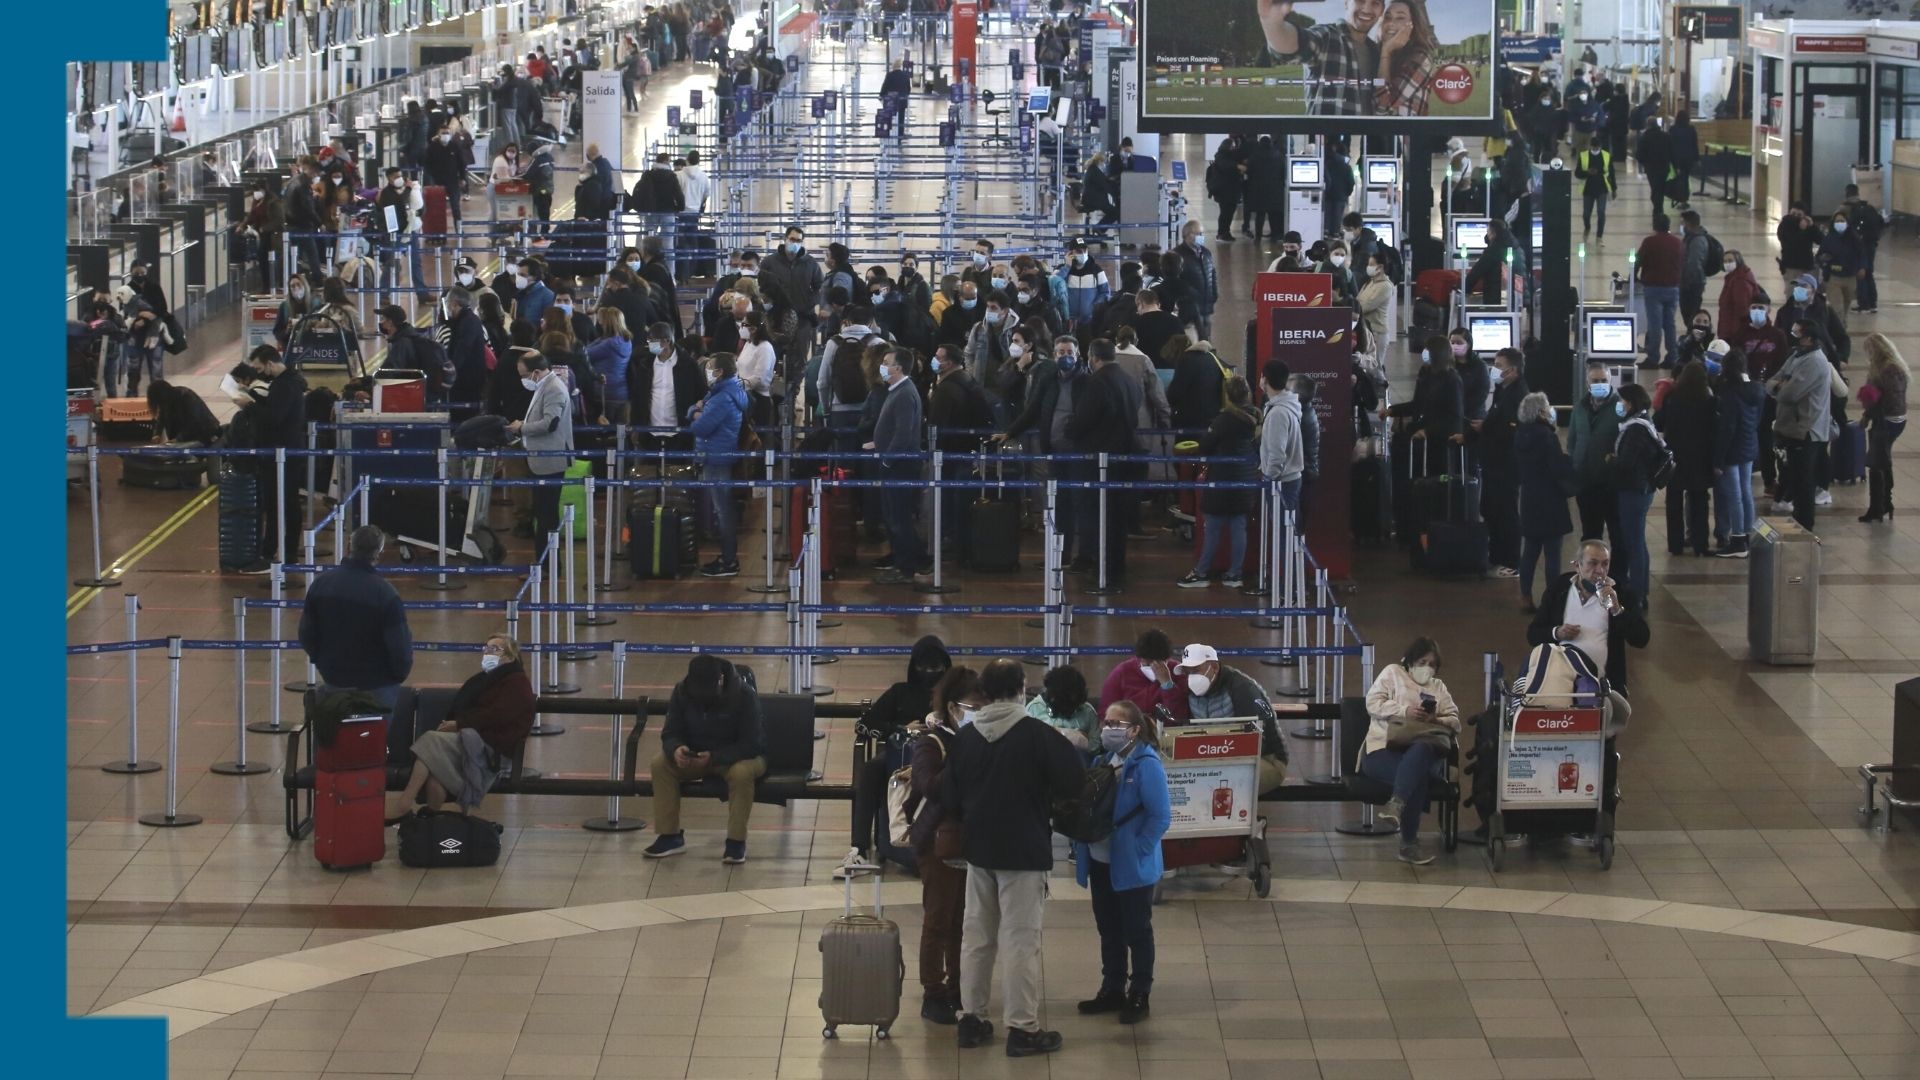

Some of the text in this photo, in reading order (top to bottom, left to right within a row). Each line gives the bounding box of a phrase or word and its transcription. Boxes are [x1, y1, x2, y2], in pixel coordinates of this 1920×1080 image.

[1435, 78, 1466, 89] Claro
[585, 86, 616, 96] Salida
[1263, 293, 1307, 302] IBERIA
[1279, 329, 1326, 339] IBERIA
[1537, 719, 1569, 729] Claro
[1197, 745, 1229, 755] Claro
